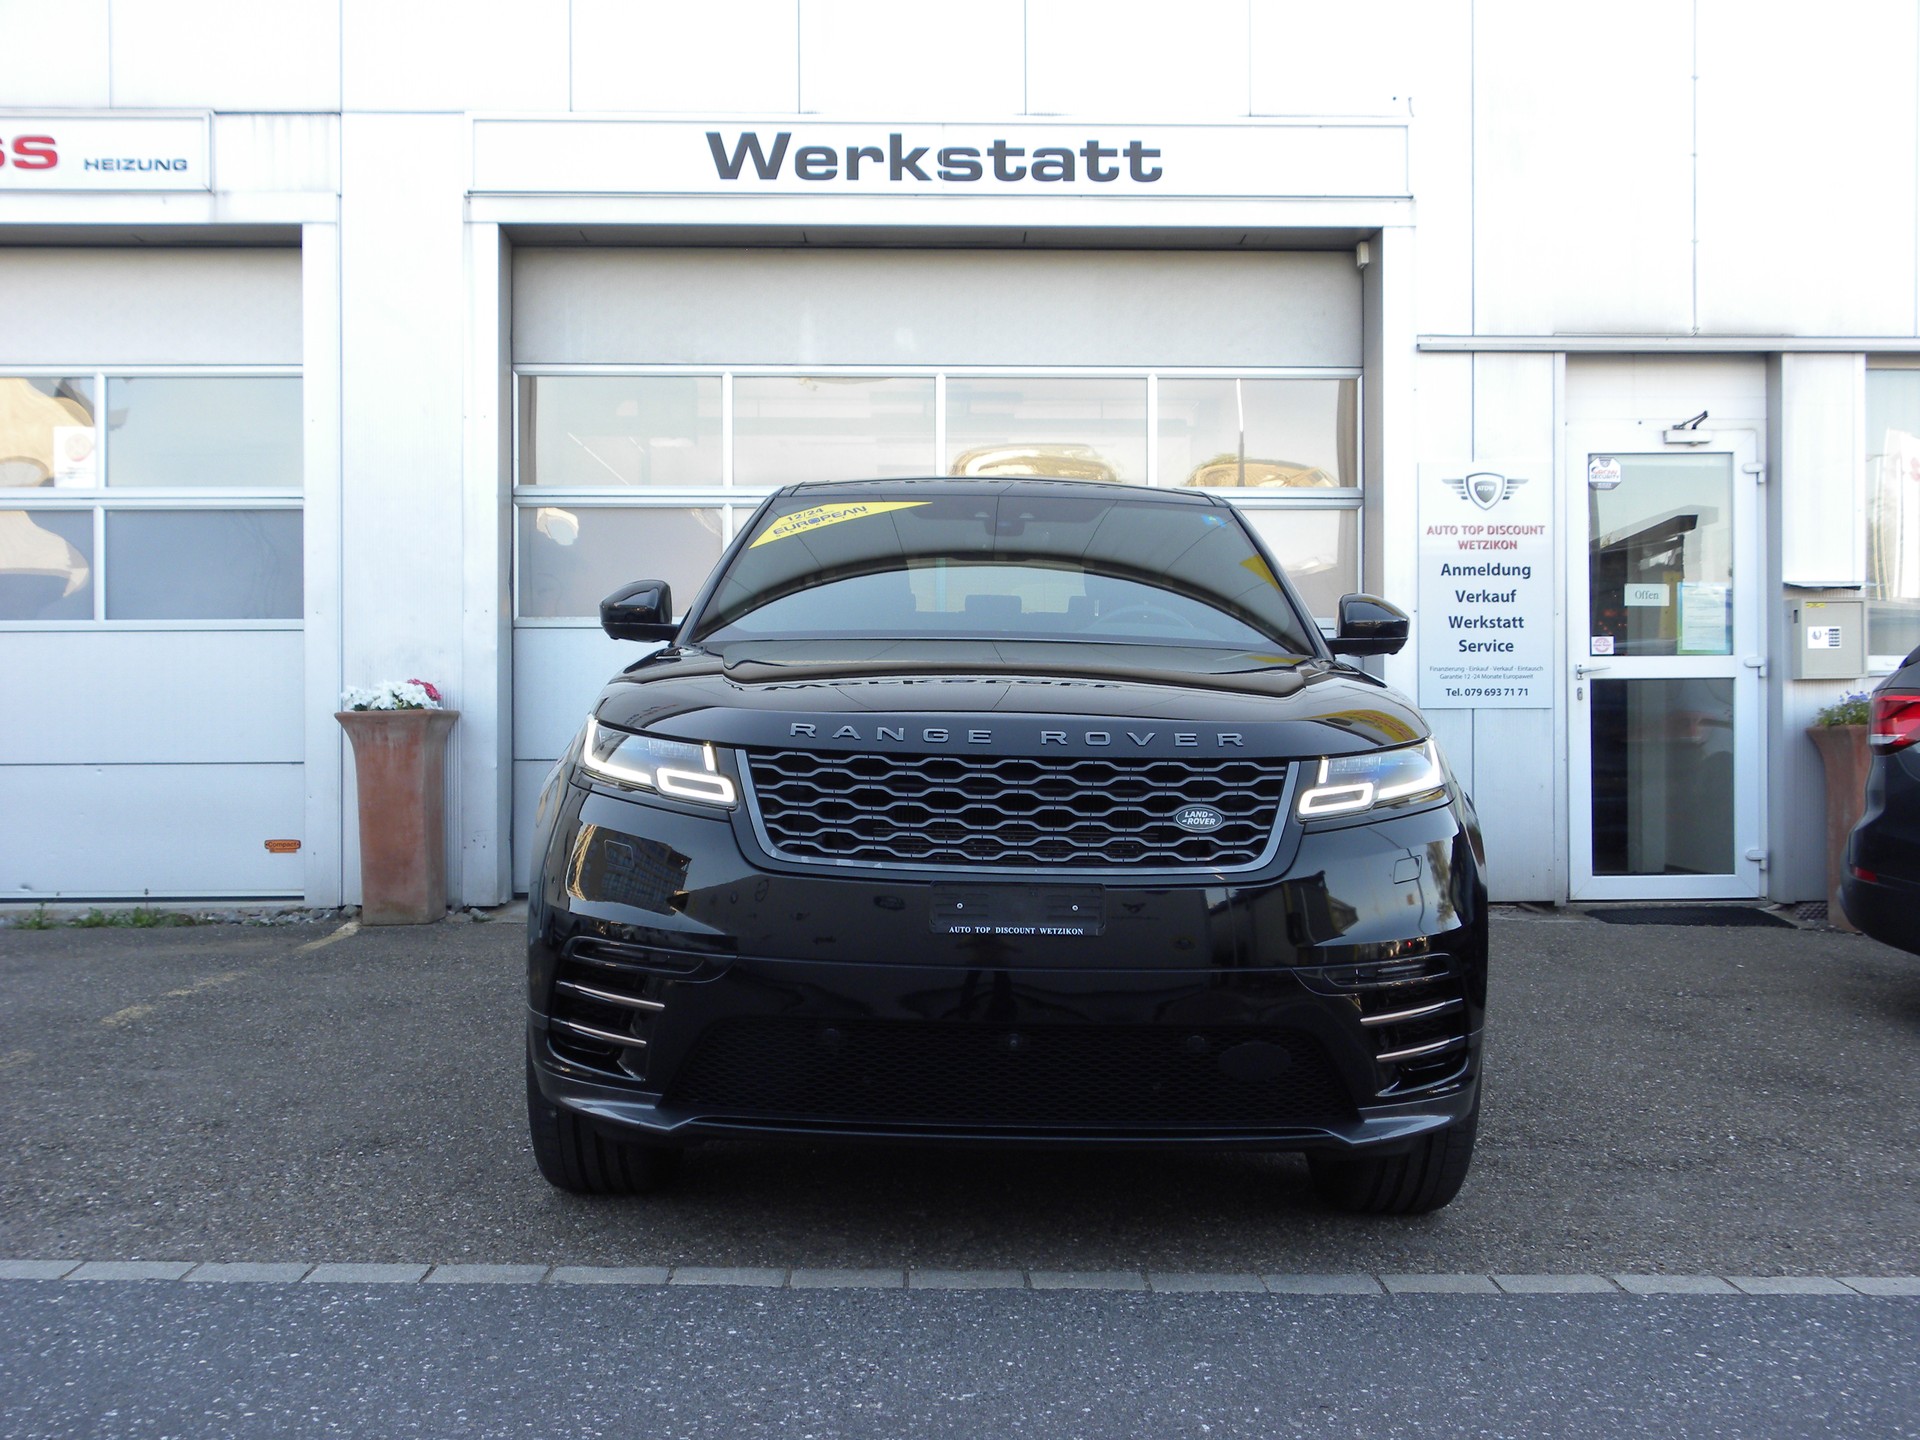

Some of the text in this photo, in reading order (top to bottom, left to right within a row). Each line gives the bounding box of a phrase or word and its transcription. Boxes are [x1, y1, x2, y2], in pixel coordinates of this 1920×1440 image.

[0, 135, 188, 171] S HEIZUNG
[705, 131, 1163, 183] Werkstatt
[773, 505, 867, 535] EUROPEAN
[787, 508, 824, 521] 12/24
[1426, 525, 1545, 536] AUTO TOP DISCOUNT
[1458, 539, 1518, 551] WETZIKON
[1440, 563, 1531, 580] Anmeldung
[1455, 589, 1517, 603] Verkauf
[1635, 590, 1659, 600] Offen
[1448, 615, 1525, 629] Werkstatt
[1458, 639, 1514, 653] Service
[1429, 665, 1465, 673] Finanzierung
[1503, 673, 1533, 681] Europaweit
[1446, 687, 1529, 697] Tel. 079 693 71 71
[789, 722, 1244, 749] RANGE ROVER
[949, 926, 1084, 935] AUTO TOP DISCOUNT WETZIKON
